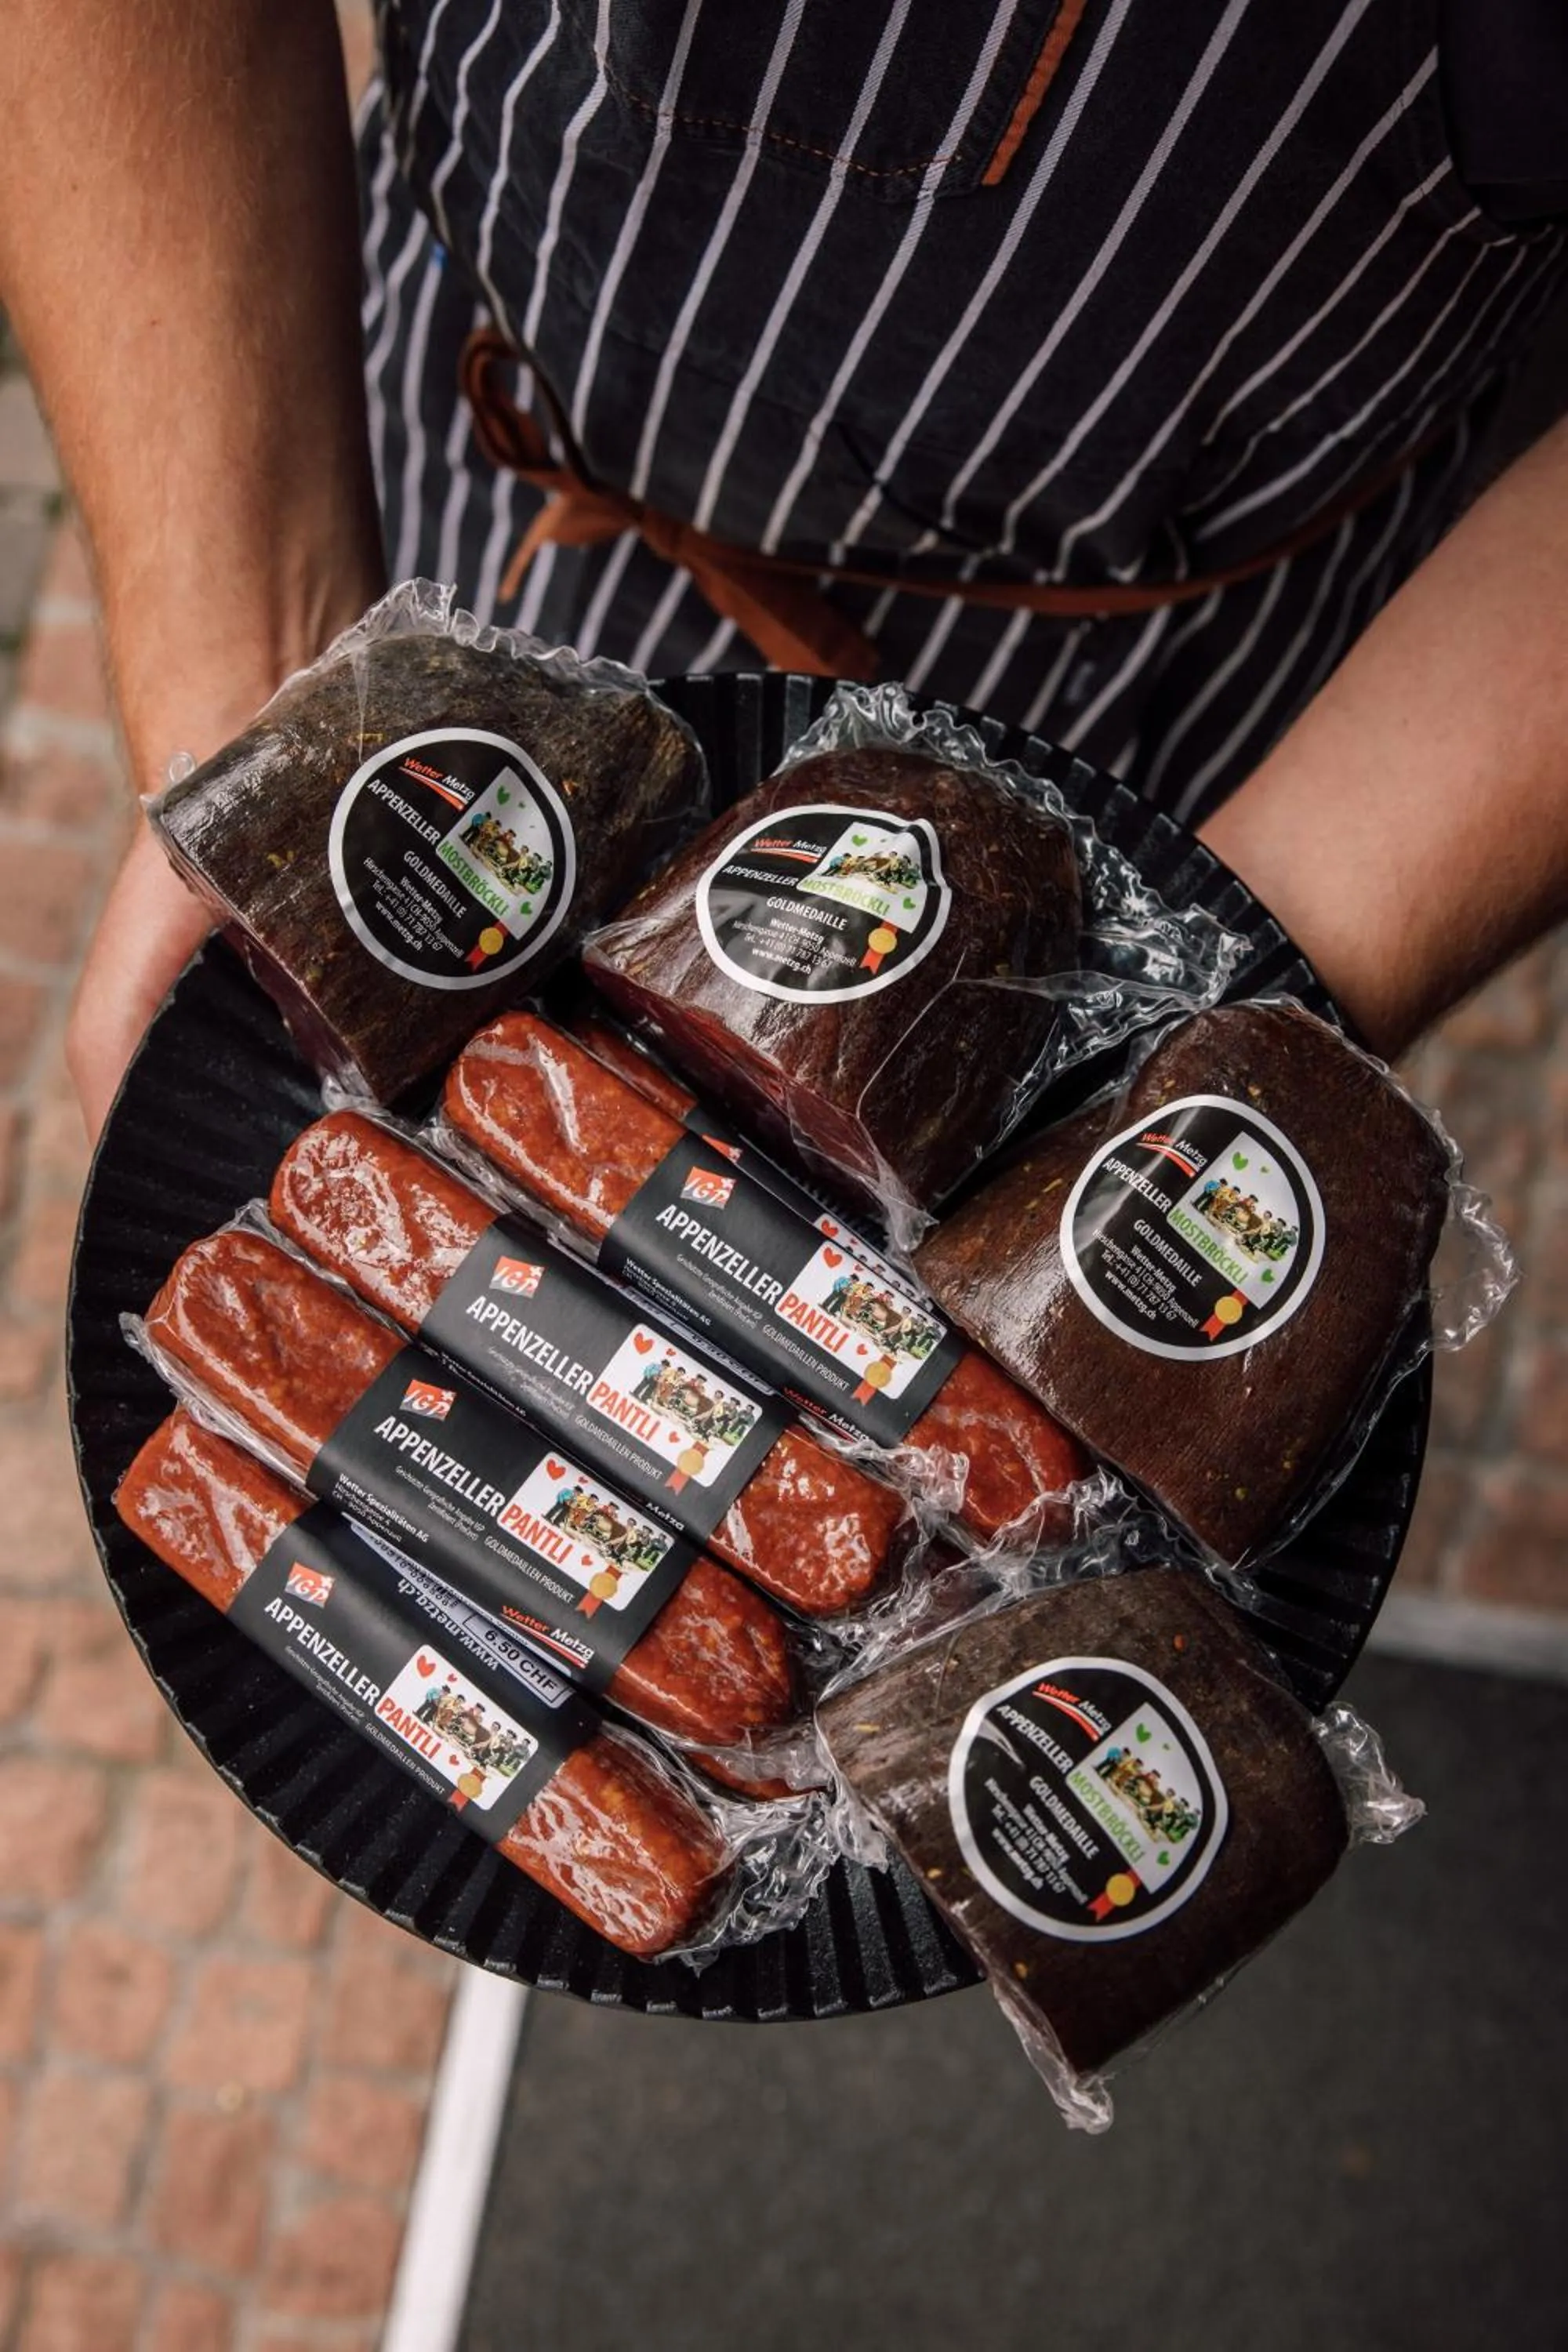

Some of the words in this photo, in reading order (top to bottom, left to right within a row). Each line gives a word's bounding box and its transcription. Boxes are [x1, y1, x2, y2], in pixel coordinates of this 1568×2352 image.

[405, 757, 443, 778] Wetter
[442, 775, 475, 800] Metzg
[368, 779, 441, 845] APPENZELLER
[439, 842, 510, 916] MOSTBRÖCKLI
[722, 864, 800, 887] APPENZELLER
[404, 851, 467, 920] GOLDMEDAILLE
[767, 896, 848, 931] GOLDMEDAILLE
[373, 900, 423, 952] www.metzg.ch
[1175, 1139, 1207, 1167] Metzg
[1102, 1156, 1173, 1214] APPENZELLER
[1168, 1208, 1248, 1284] MOSTBRÖCKLI
[1134, 1219, 1202, 1287] GOLDMEDAILLE
[655, 1204, 783, 1305] APPENZELLER
[778, 1293, 849, 1354] PANTLI
[1103, 1270, 1159, 1322] www.metzg.ch
[1130, 1245, 1177, 1294] Wetter-Metzg
[466, 1297, 594, 1396] APPENZELLER
[590, 1381, 661, 1441] PANTLI
[761, 1323, 818, 1370] GOLDMEDAILLEN
[815, 1363, 850, 1392] PRODUKT
[574, 1414, 631, 1459] GOLDMEDAILLEN
[627, 1452, 662, 1480] PRODUKT
[337, 1473, 367, 1498] Wetter
[364, 1492, 417, 1534] Spezialitäten
[415, 1529, 430, 1543] AG
[373, 1416, 506, 1516] APPENZELLER
[501, 1504, 574, 1565] PANTLI
[483, 1534, 542, 1581] GOLDMEDAILLEN
[539, 1574, 575, 1604] PRODUKT
[394, 1577, 500, 1671] www.metzg.ch
[503, 1605, 549, 1632] Wetter
[550, 1628, 594, 1660] Metzg
[264, 1597, 382, 1707] APPENZELLER
[376, 1697, 441, 1760] PANTLI
[484, 1628, 520, 1661] 6.50
[519, 1658, 557, 1693] CHF
[1078, 1700, 1112, 1731] Metzg
[413, 1766, 445, 1795] PRODUKT
[996, 1704, 1074, 1775] APPENZELLER
[1069, 1771, 1145, 1864] MOSTBRÖCKLI
[1029, 1776, 1100, 1860] GOLDMEDAILLE
